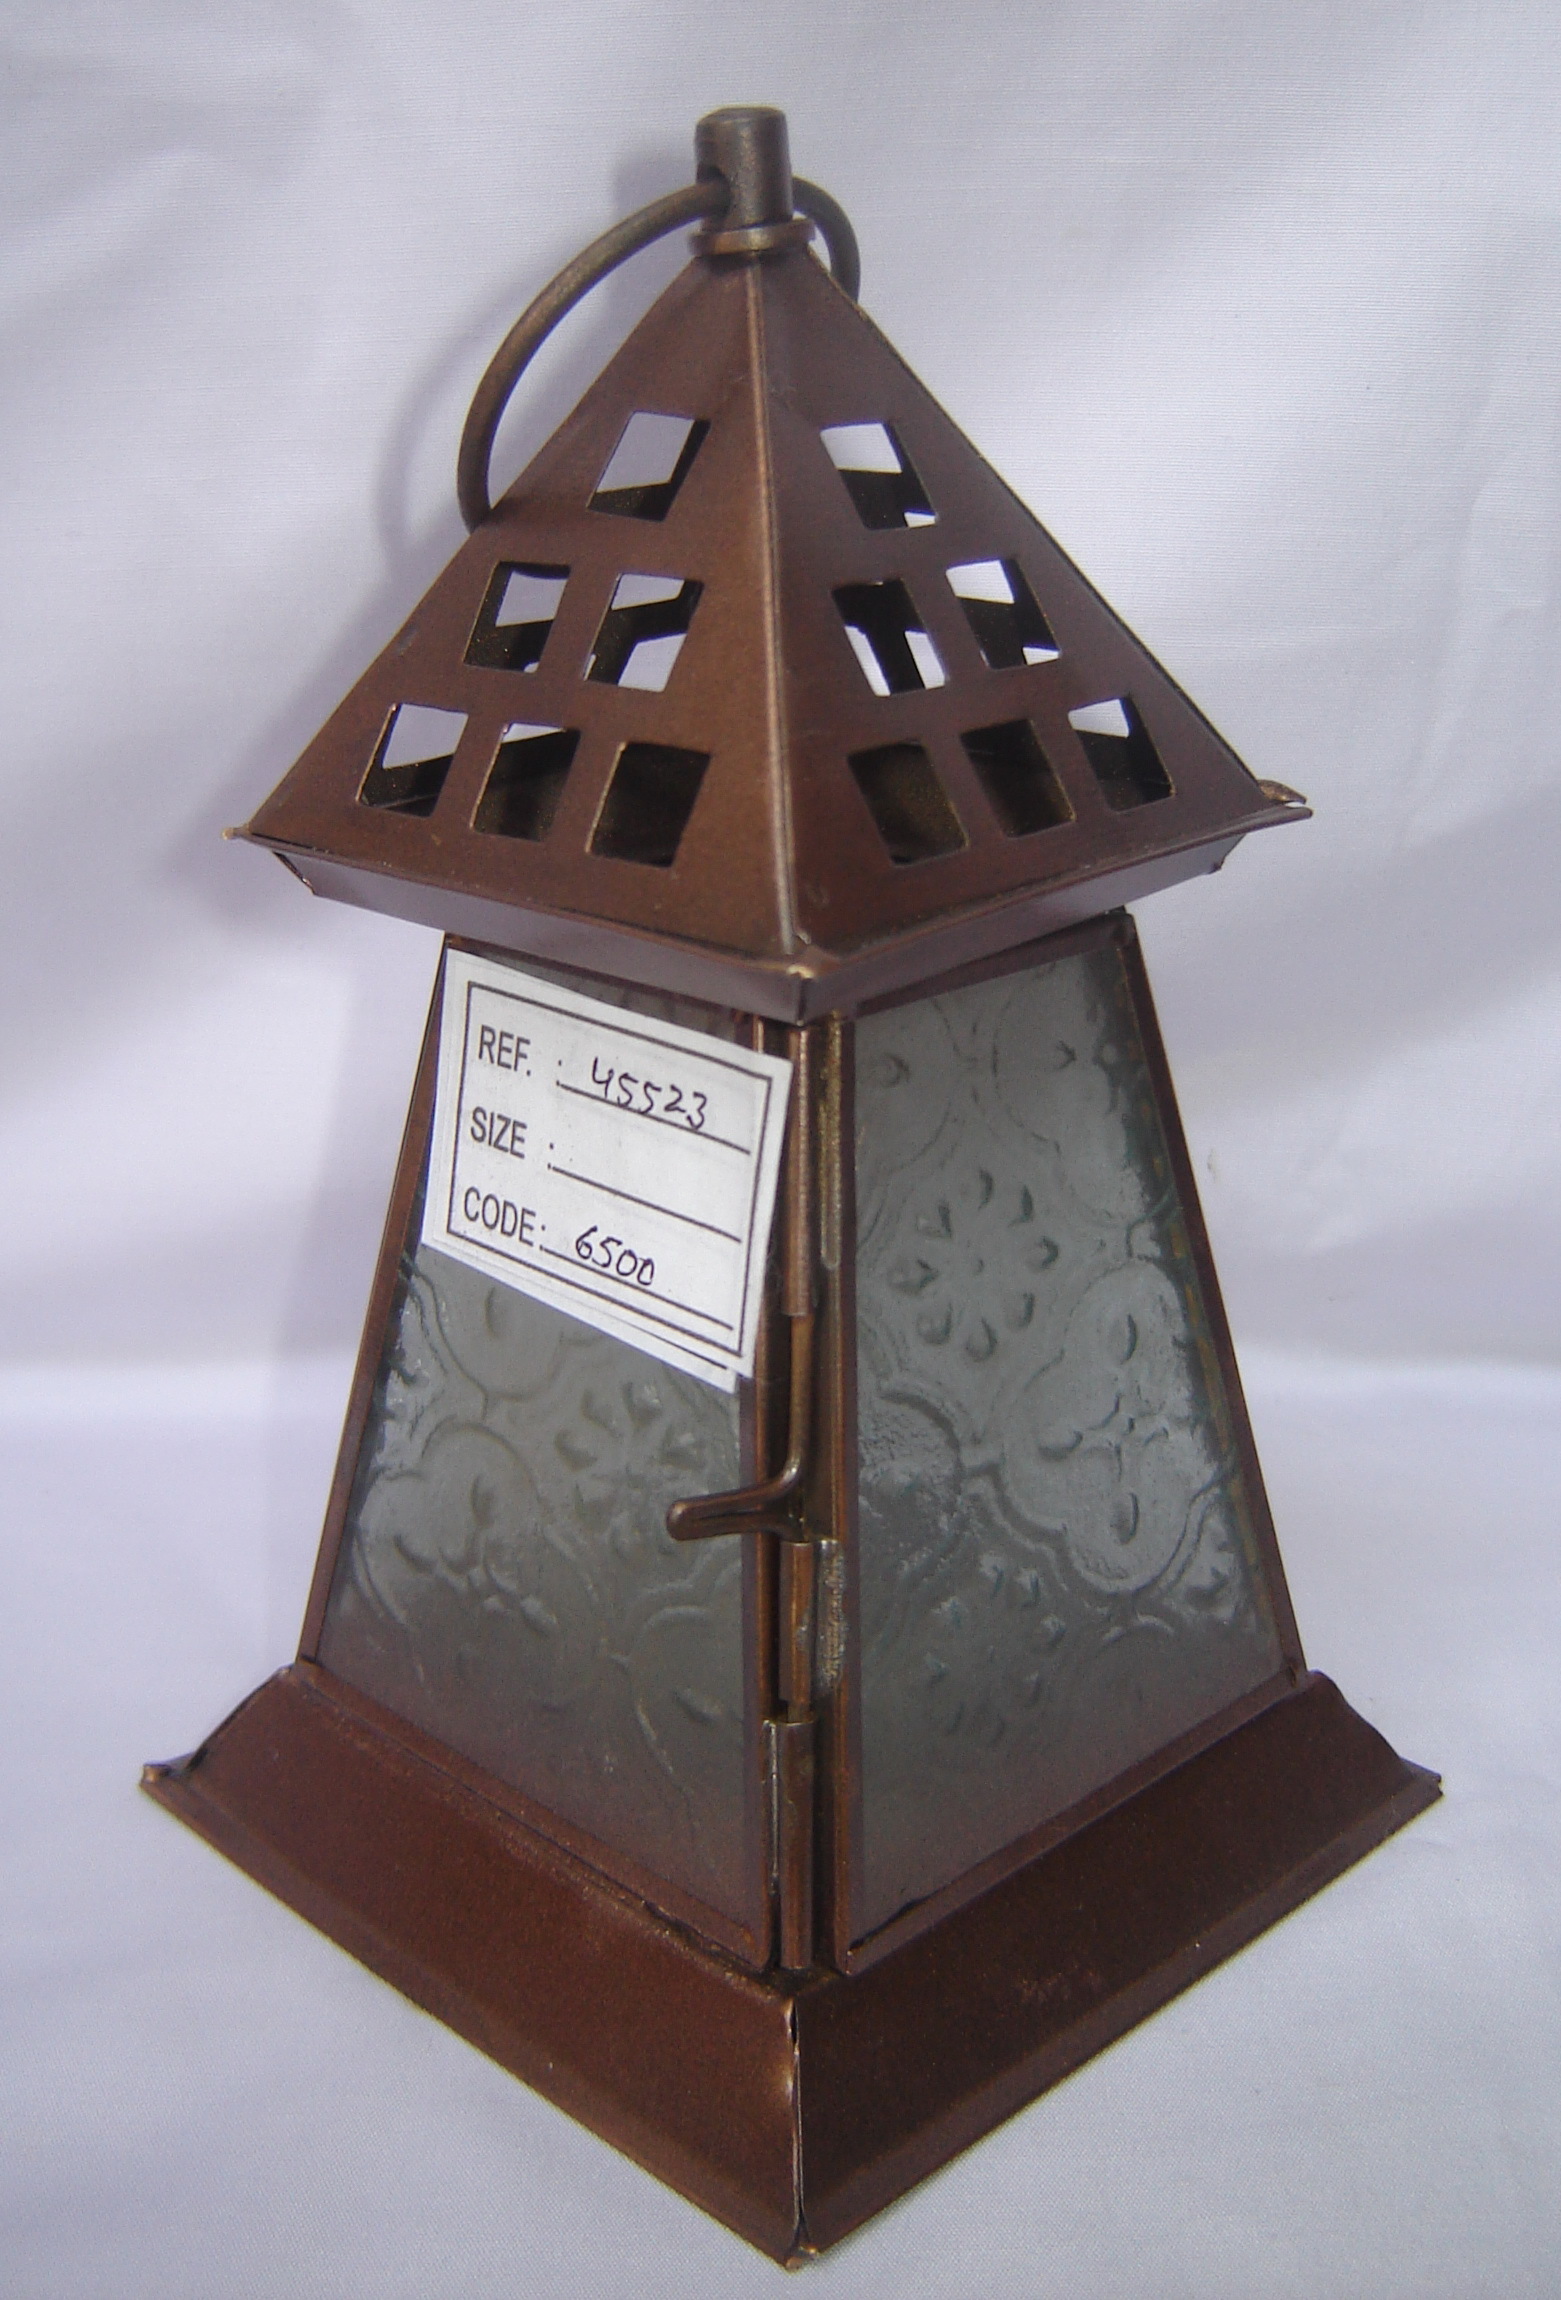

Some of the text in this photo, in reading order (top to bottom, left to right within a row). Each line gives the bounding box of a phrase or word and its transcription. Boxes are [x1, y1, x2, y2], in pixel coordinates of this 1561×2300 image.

[591, 1056, 708, 1130] 45523
[470, 1106, 527, 1159] SIZE
[575, 1225, 655, 1286] 6500
